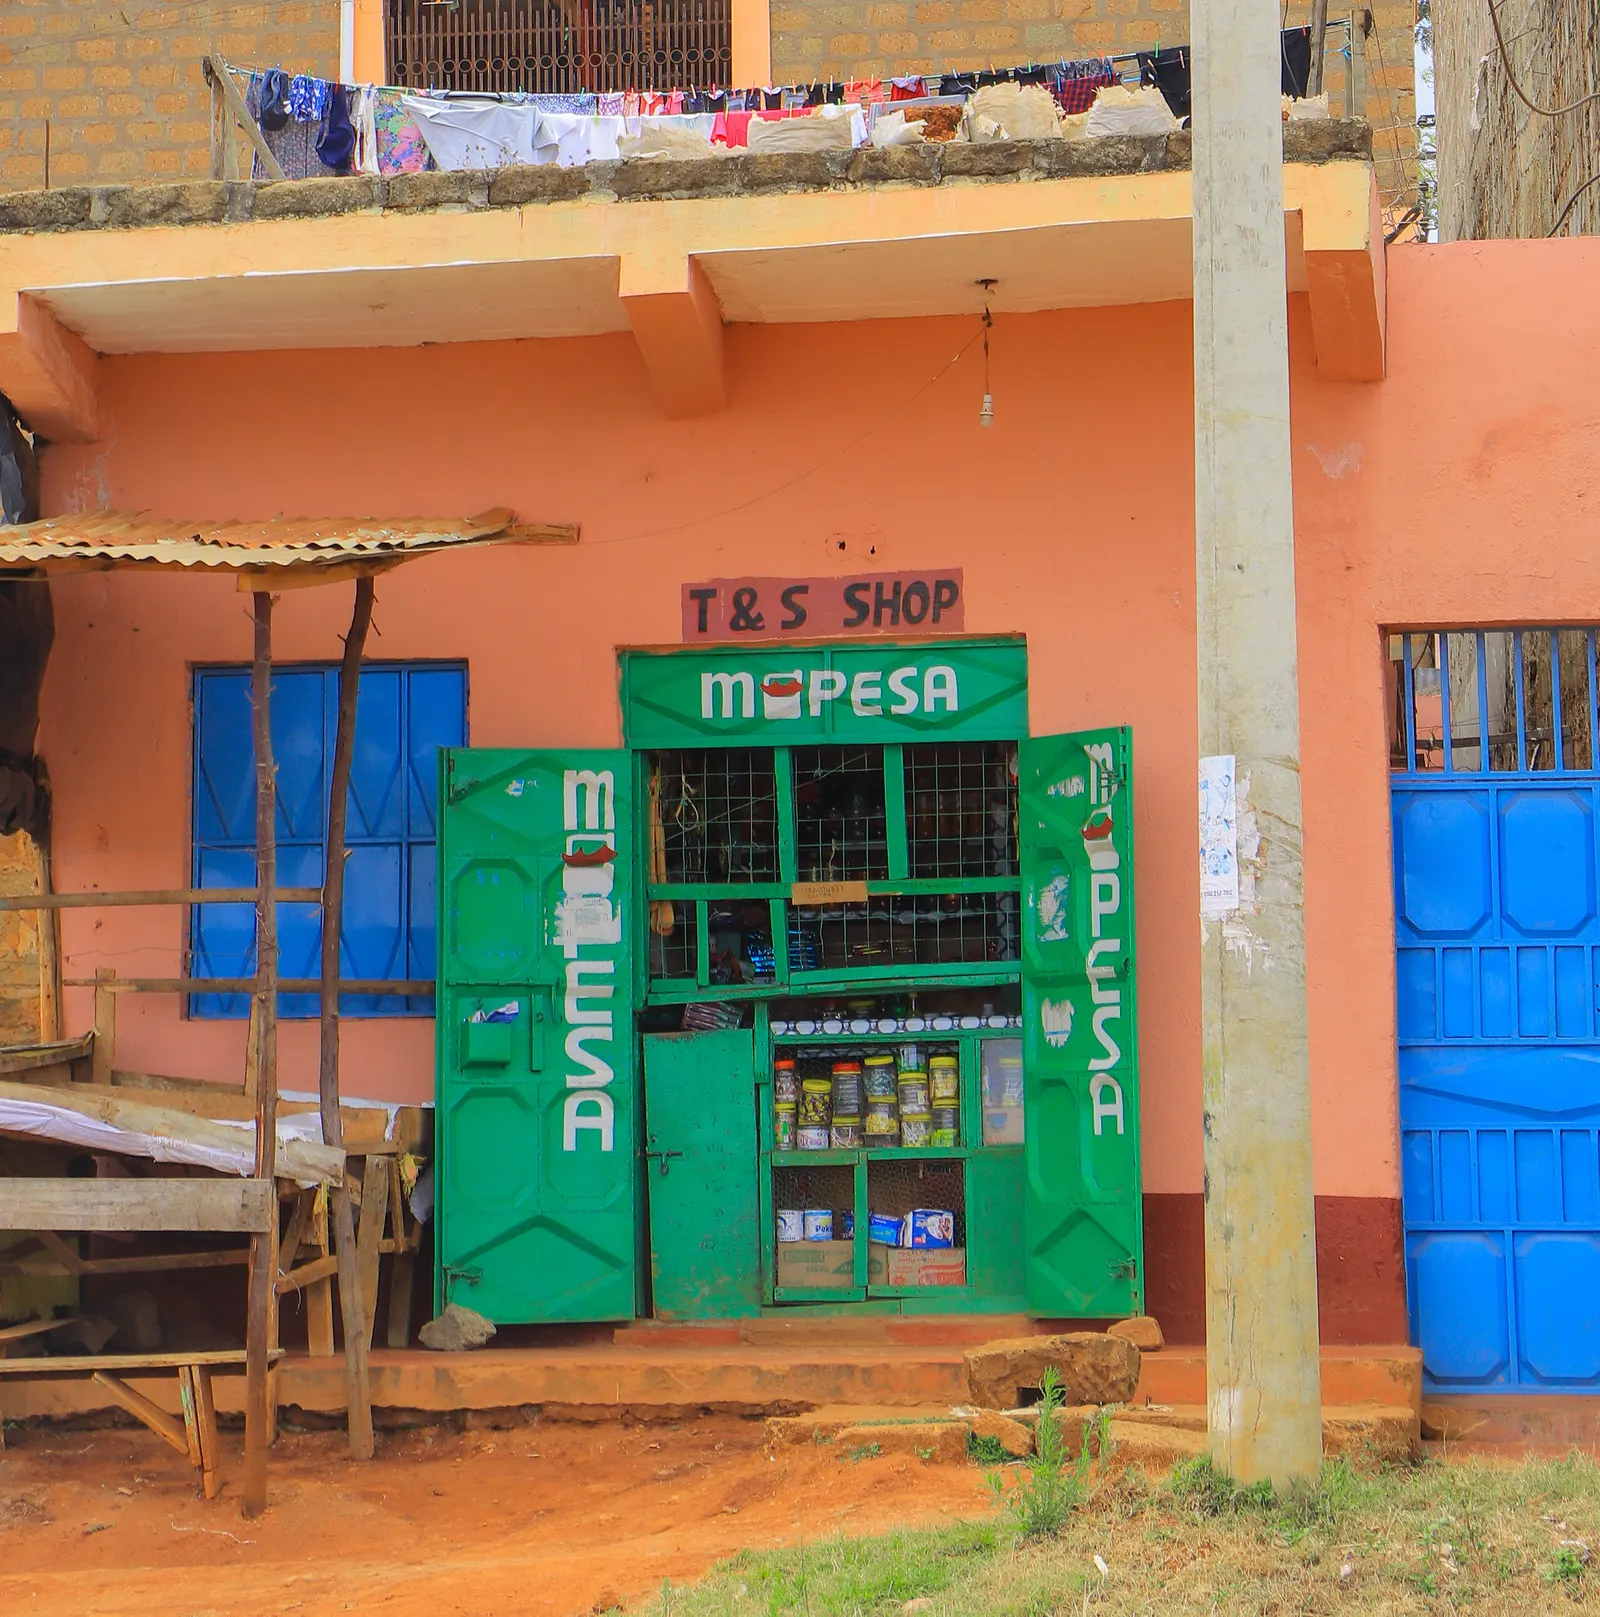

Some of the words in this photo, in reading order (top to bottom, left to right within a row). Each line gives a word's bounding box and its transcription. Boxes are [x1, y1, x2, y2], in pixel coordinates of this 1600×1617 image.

[689, 588, 717, 632] T
[729, 586, 765, 631] &
[780, 585, 809, 630] S
[843, 579, 960, 628] SHOP
